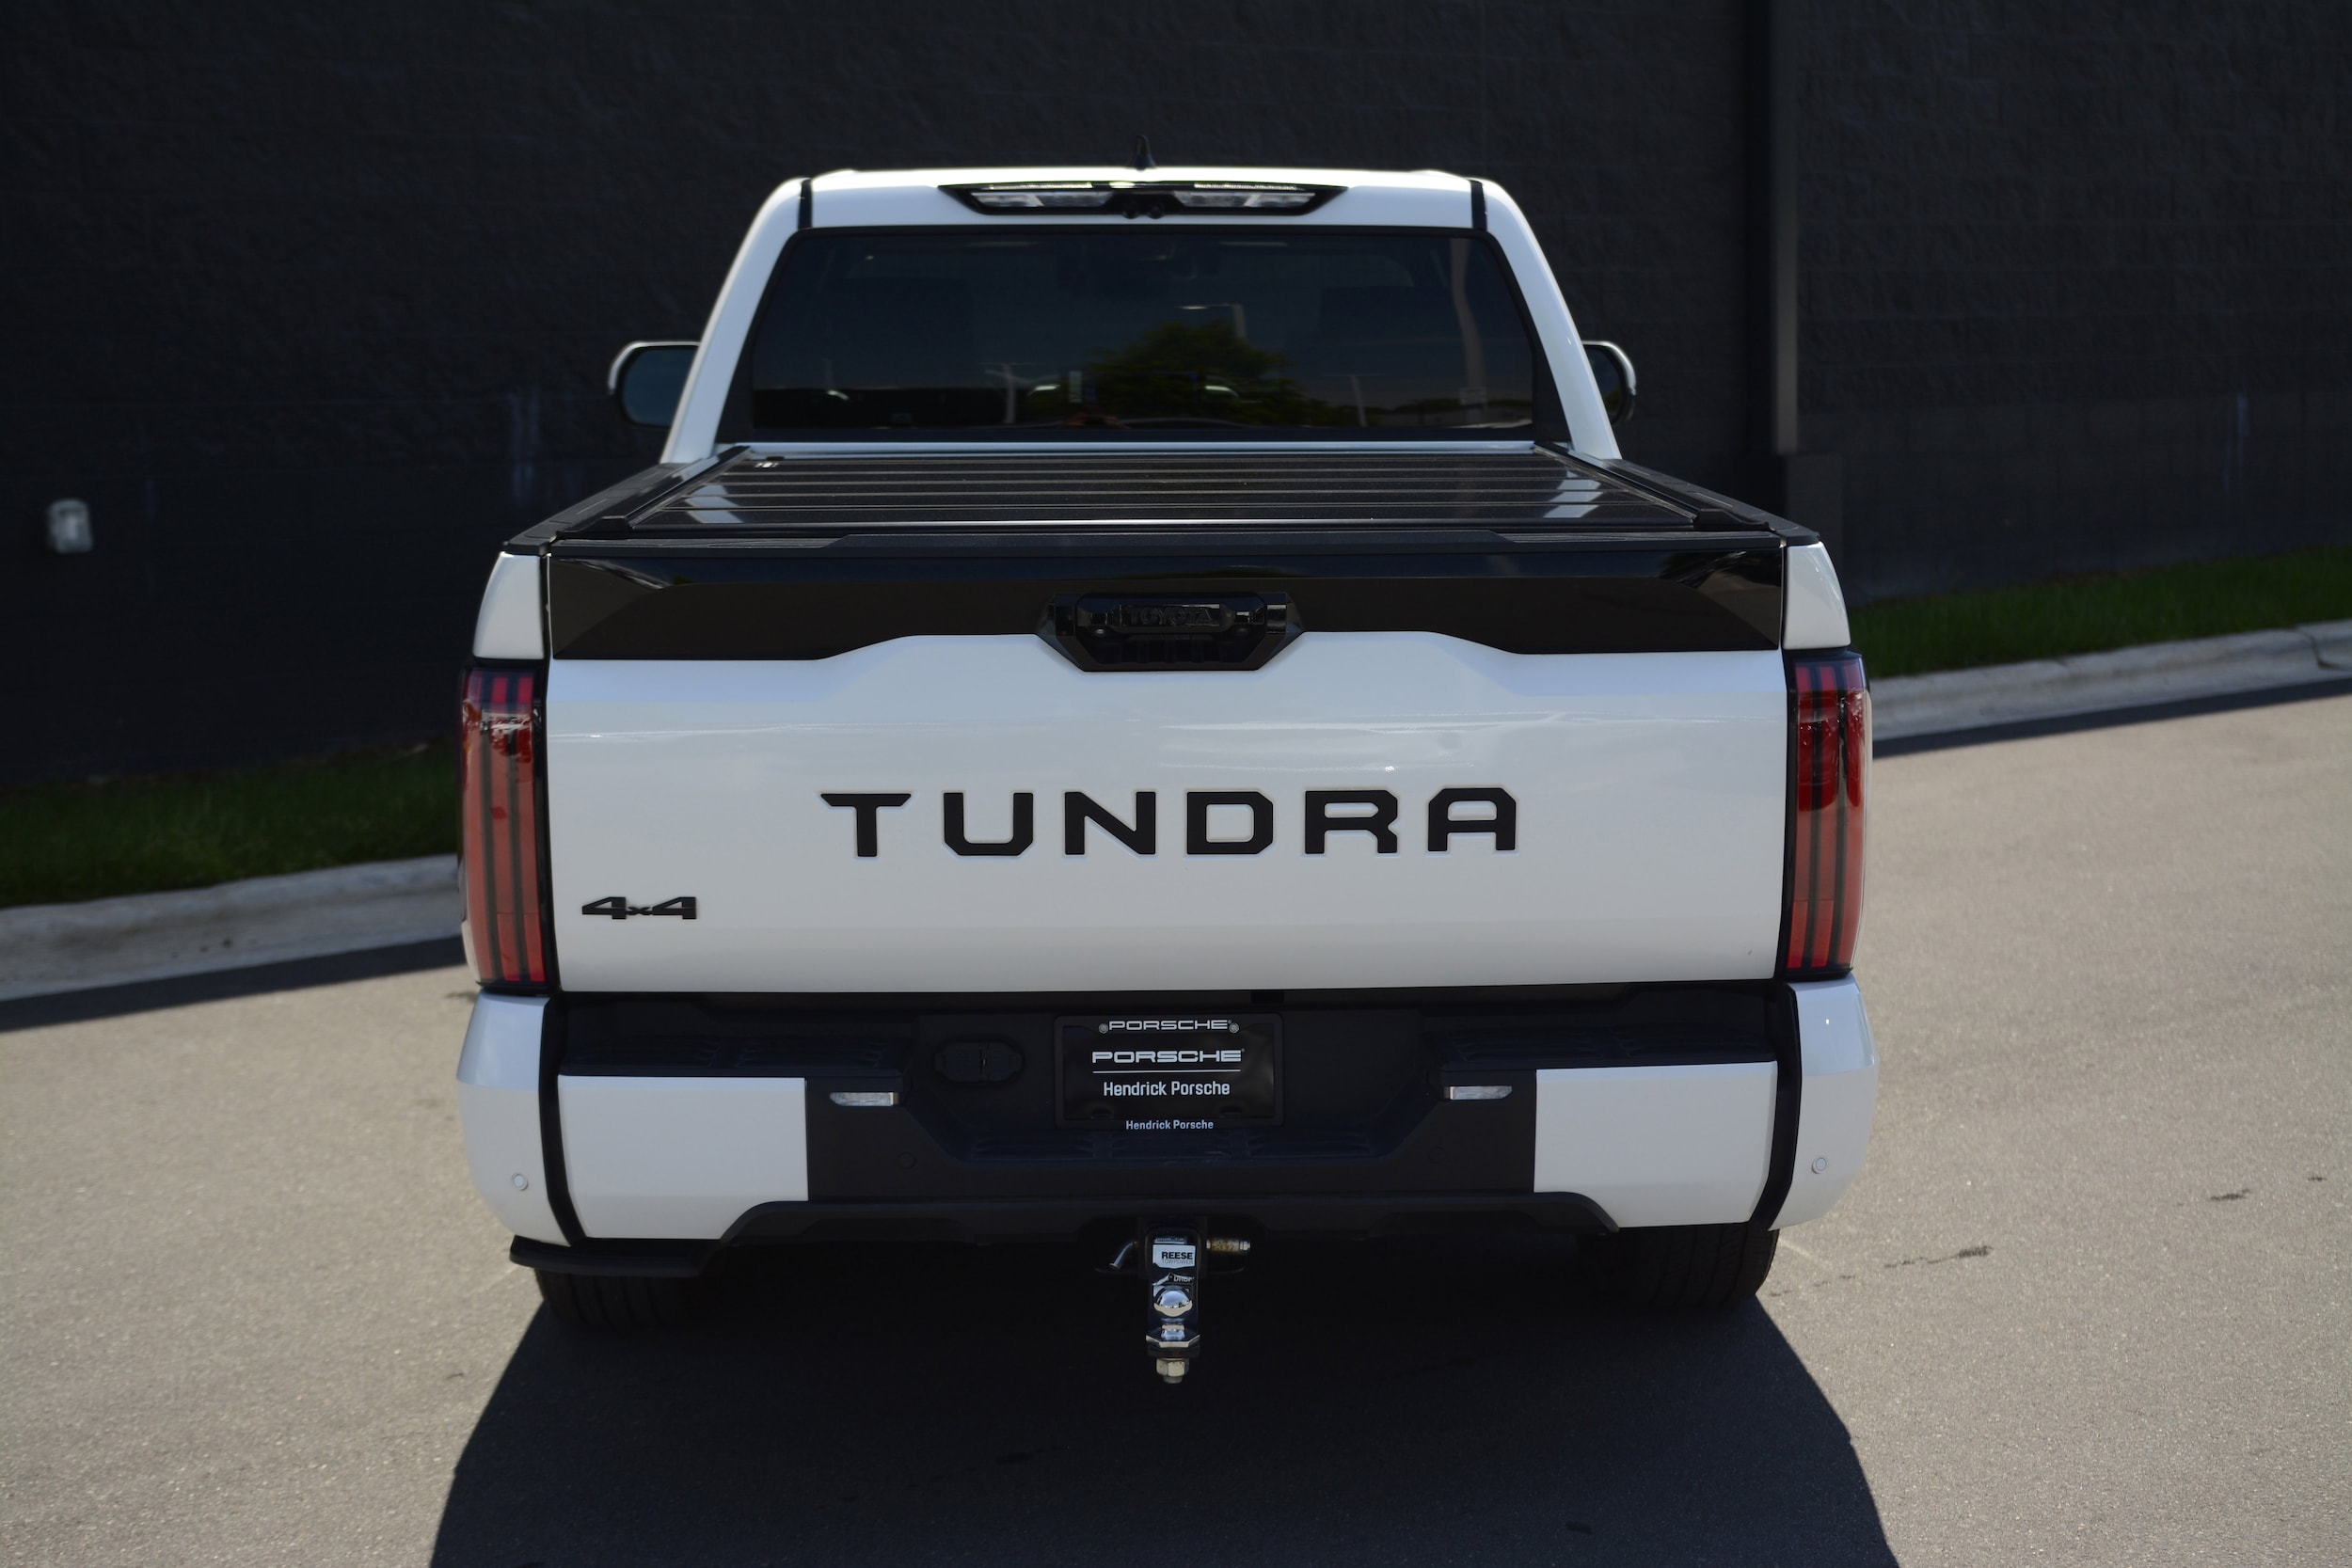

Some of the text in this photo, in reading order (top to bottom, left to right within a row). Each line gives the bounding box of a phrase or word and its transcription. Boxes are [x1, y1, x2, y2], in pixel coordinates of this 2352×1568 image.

[1128, 607, 1213, 626] TOYOTA
[820, 786, 1517, 858] TUNDRA
[581, 896, 697, 920] 4x4
[1108, 1020, 1228, 1031] PORSCHE
[1091, 1050, 1242, 1064] PORSCHE
[1103, 1081, 1231, 1096] Hendrick Porsche
[1125, 1119, 1215, 1131] Hendrick Porsche
[1161, 1251, 1194, 1259] REESE
